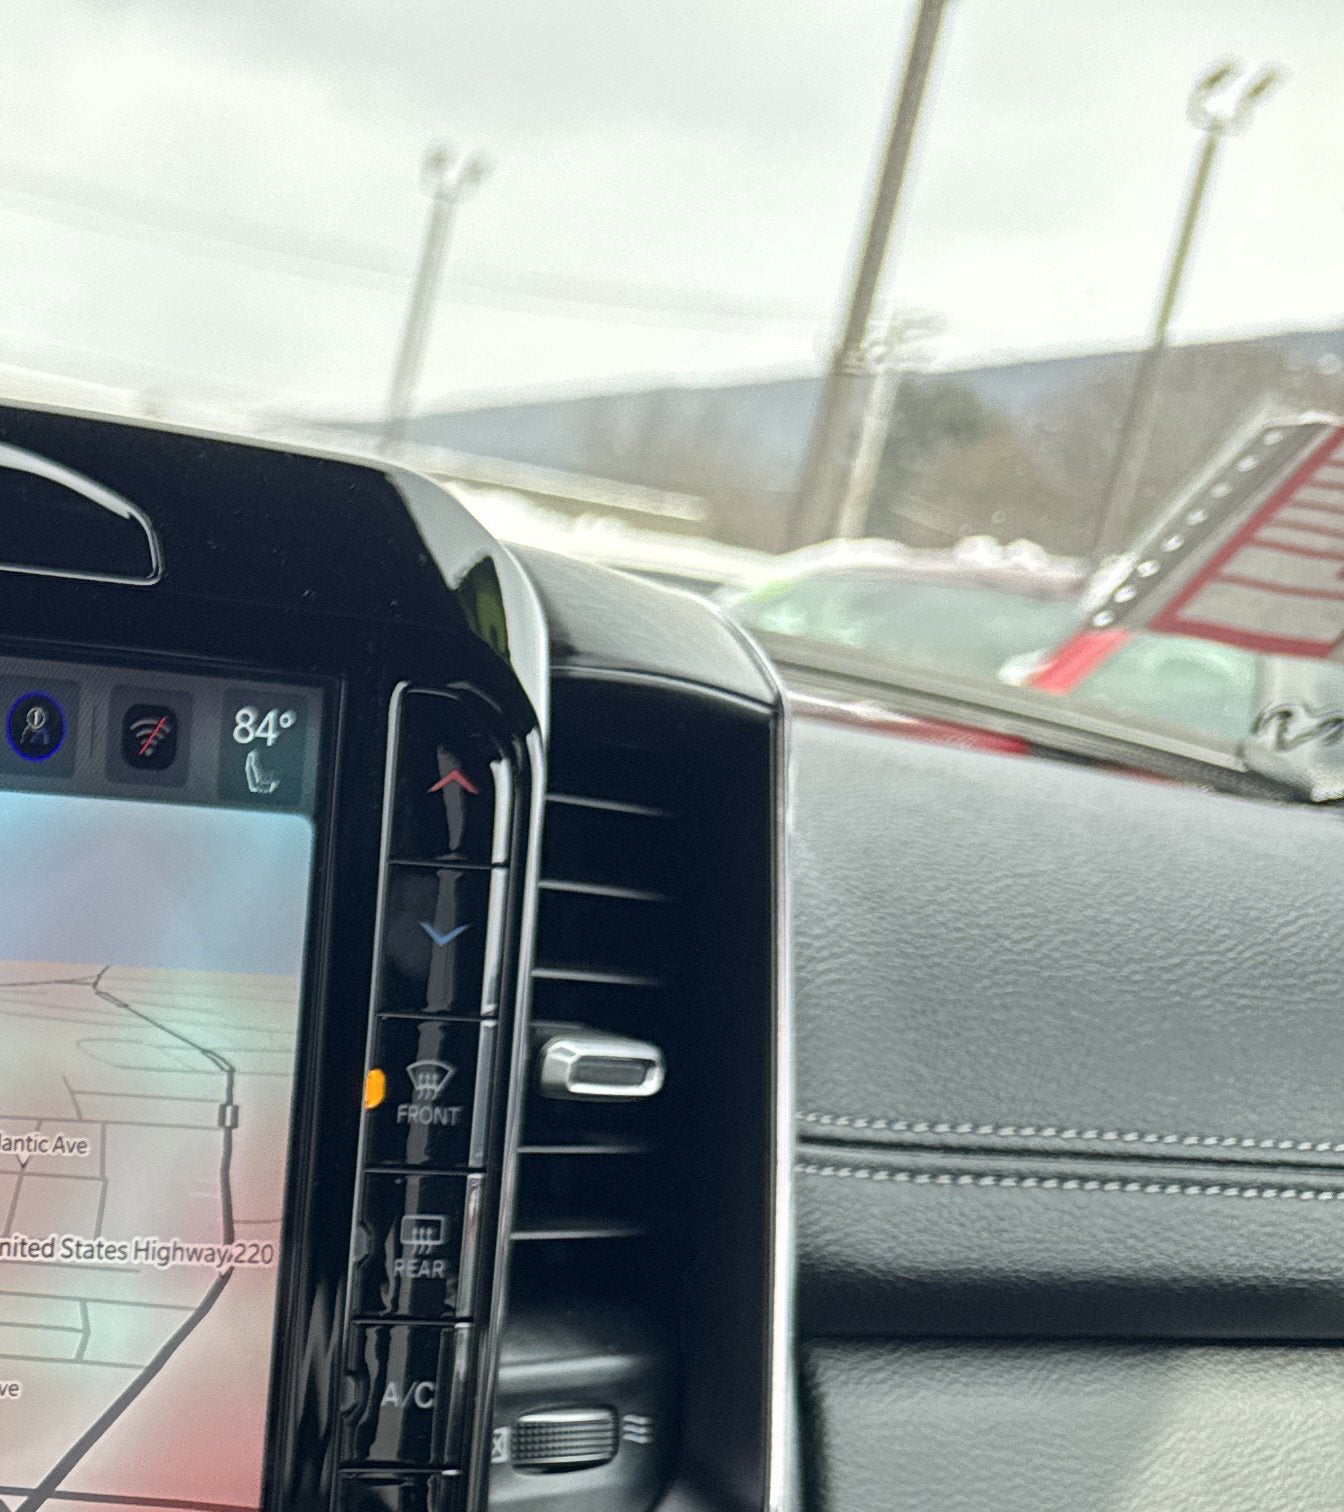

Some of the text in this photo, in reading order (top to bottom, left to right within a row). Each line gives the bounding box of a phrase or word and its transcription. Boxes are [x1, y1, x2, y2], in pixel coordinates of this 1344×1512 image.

[396, 1104, 461, 1126] FRONT
[50, 1136, 89, 1155] Ave
[60, 1238, 128, 1262] States
[133, 1241, 227, 1267] Highway
[233, 1244, 274, 1265] 220
[393, 1258, 445, 1280] REAR
[381, 1380, 434, 1410] A/C
